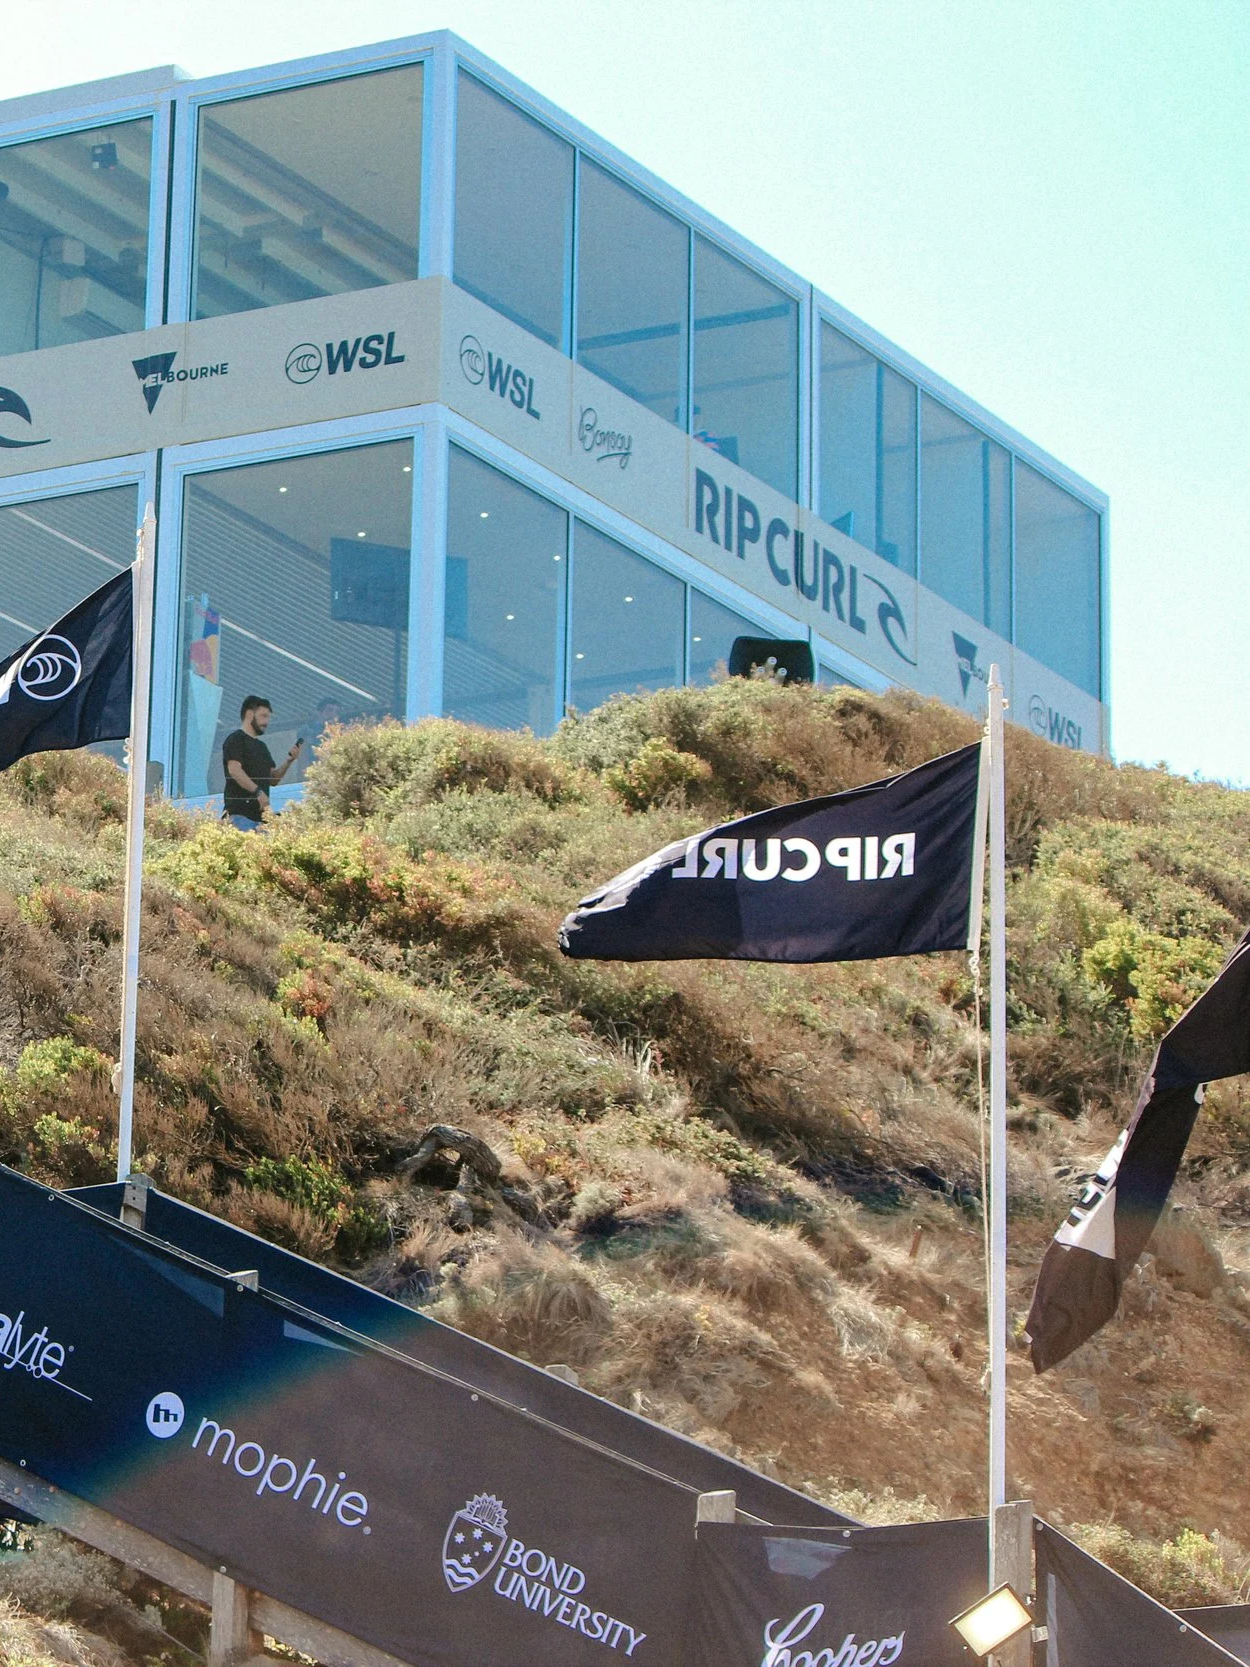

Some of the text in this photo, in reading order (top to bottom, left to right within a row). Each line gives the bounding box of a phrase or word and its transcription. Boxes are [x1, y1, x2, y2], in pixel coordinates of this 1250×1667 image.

[139, 362, 229, 388] MELBOURNE
[325, 331, 406, 375] WSL
[488, 350, 541, 421] WSL
[578, 405, 632, 469] Bonsoy
[695, 467, 866, 635] RIPCURL
[192, 1417, 368, 1527] mophie
[502, 1538, 586, 1595] BOND
[493, 1566, 647, 1657] UNIVERSITY
